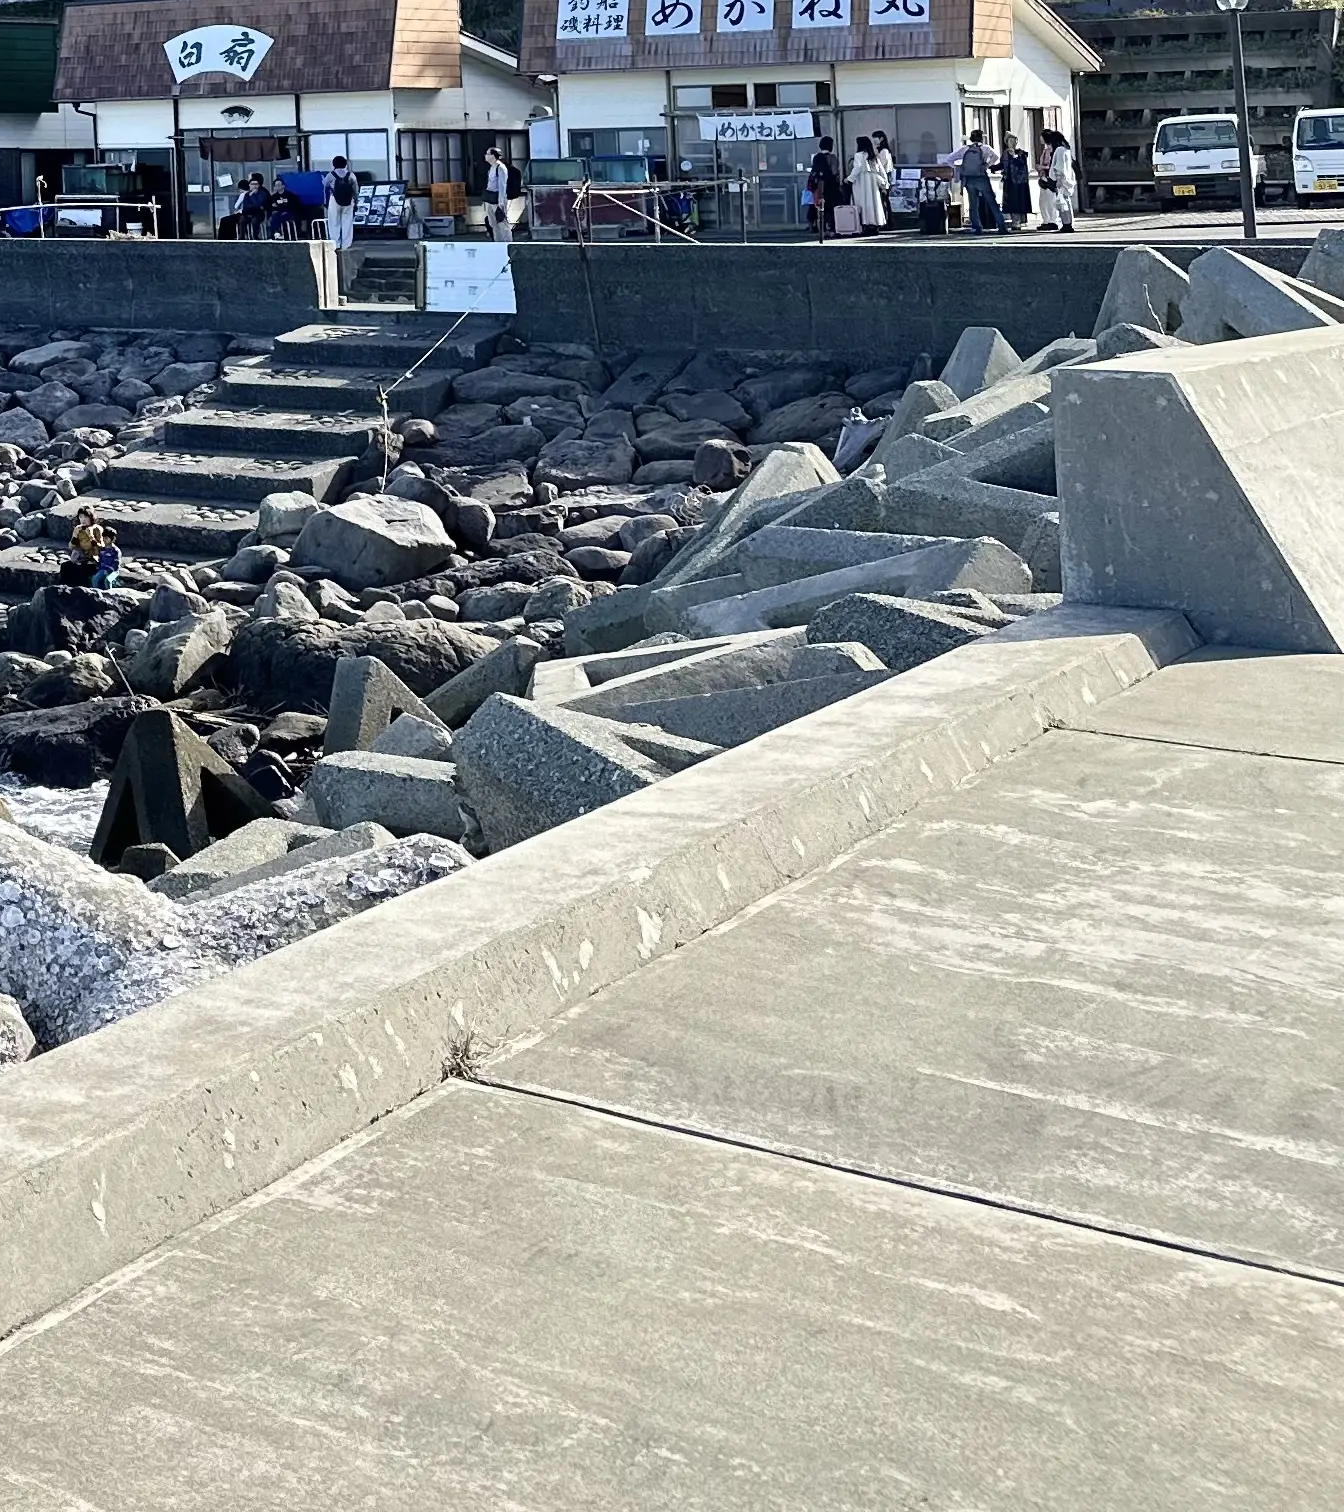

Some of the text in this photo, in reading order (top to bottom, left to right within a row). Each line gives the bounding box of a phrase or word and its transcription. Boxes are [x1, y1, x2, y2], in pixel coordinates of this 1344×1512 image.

[560, 14, 625, 35] 磯料理
[178, 31, 256, 72] 白扇
